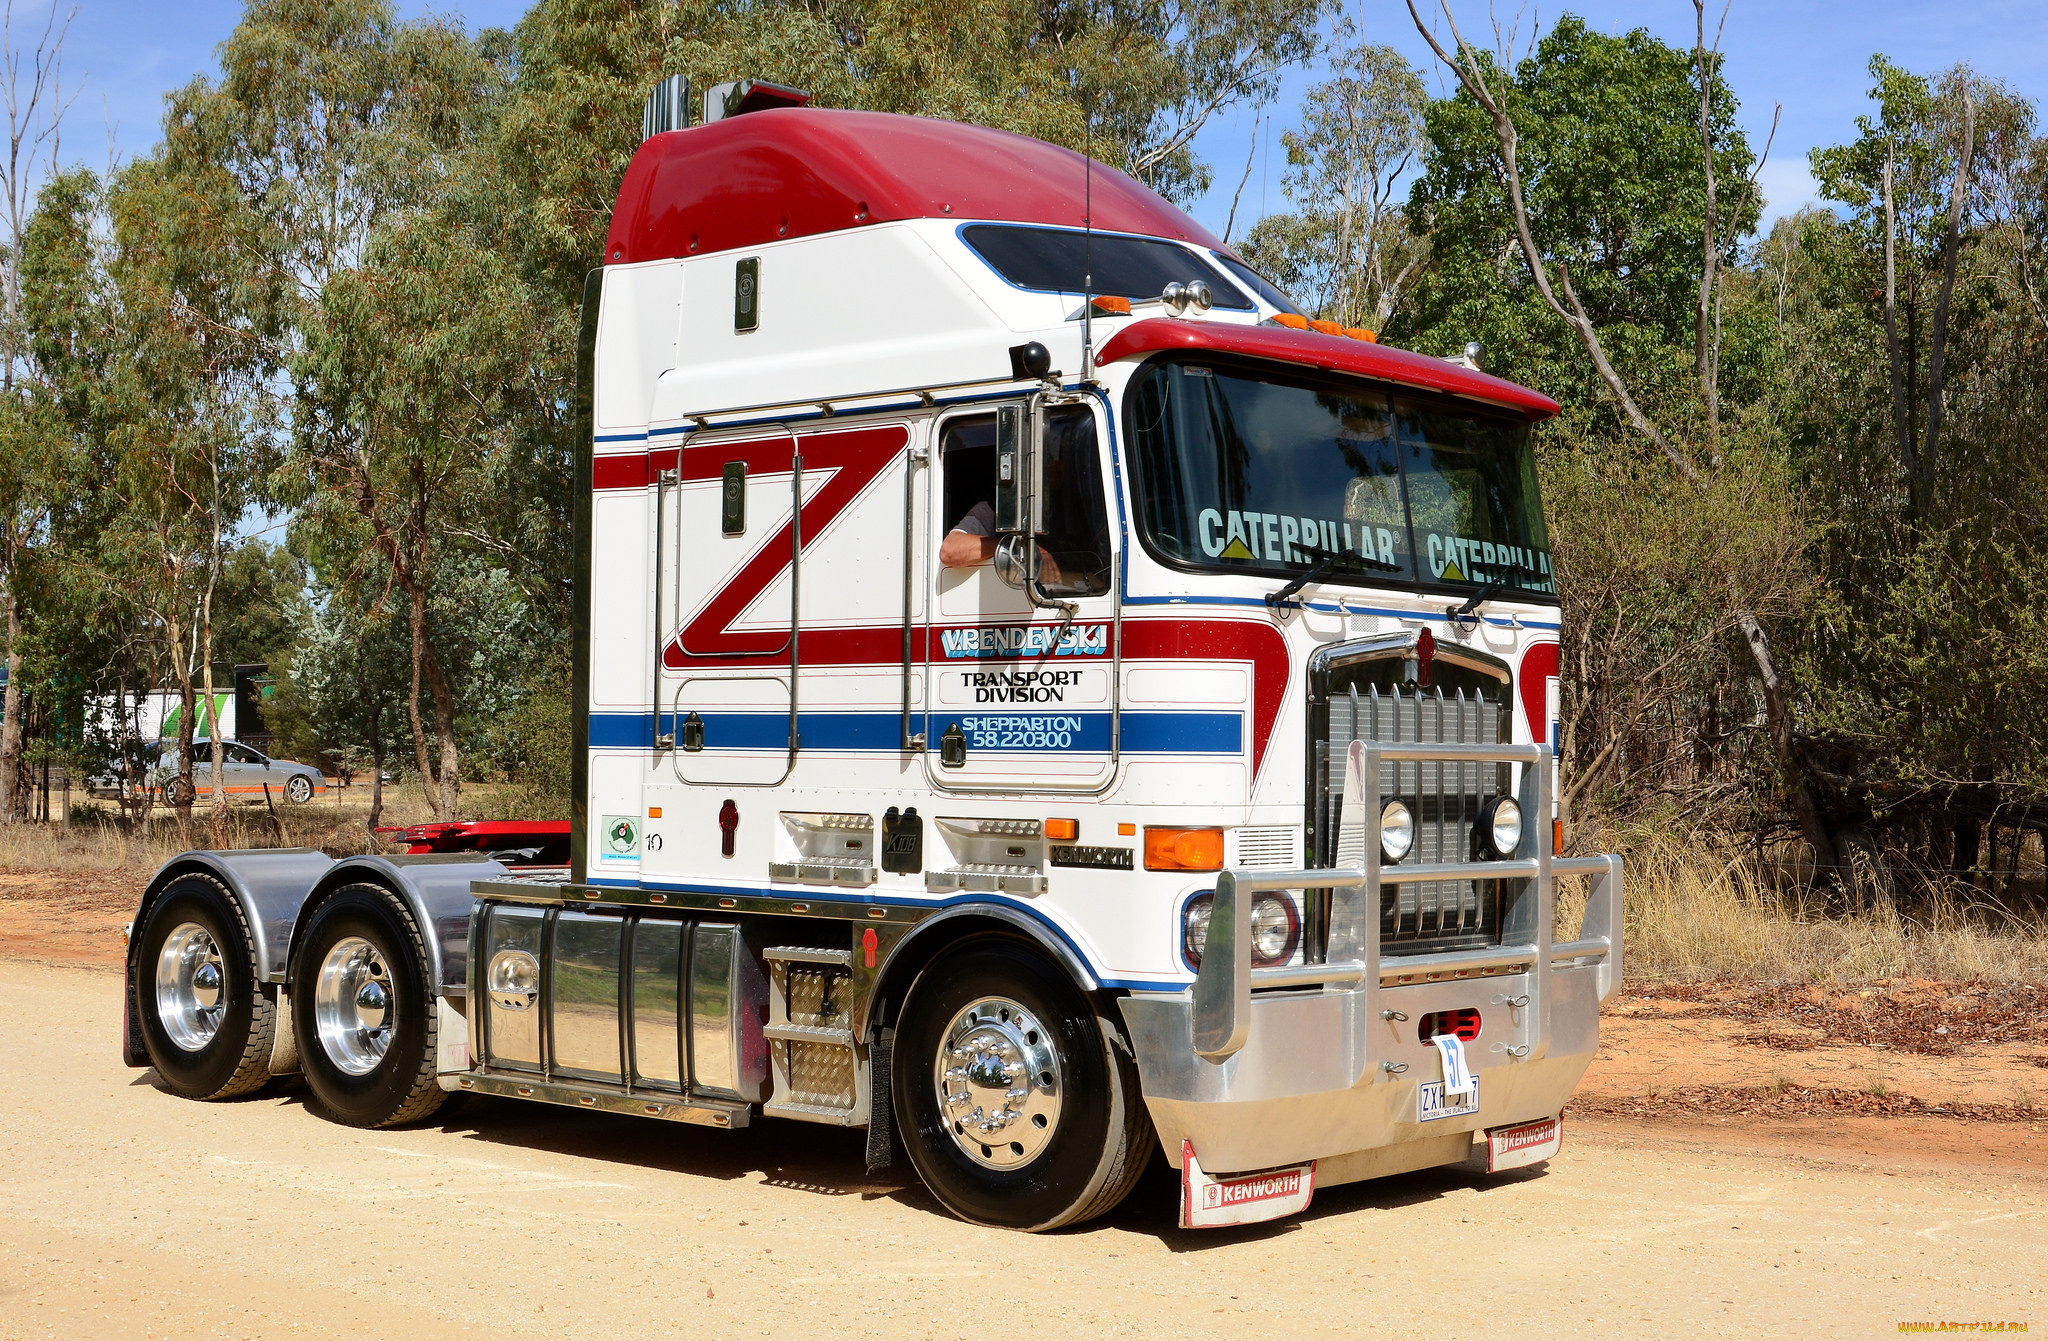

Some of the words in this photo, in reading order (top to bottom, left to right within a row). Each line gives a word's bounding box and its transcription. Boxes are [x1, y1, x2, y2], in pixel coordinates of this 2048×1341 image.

[1427, 533, 1557, 594] CATERPILLA
[961, 671, 1083, 687] TRANSPORT
[976, 687, 1064, 703] DIVISION
[962, 717, 1081, 732] SHEPPARTON
[1051, 845, 1134, 866] KENWORTH
[1441, 1039, 1461, 1088] 57
[1508, 1123, 1555, 1148] KENWORTH
[1223, 1174, 1299, 1202] KENWORTH
